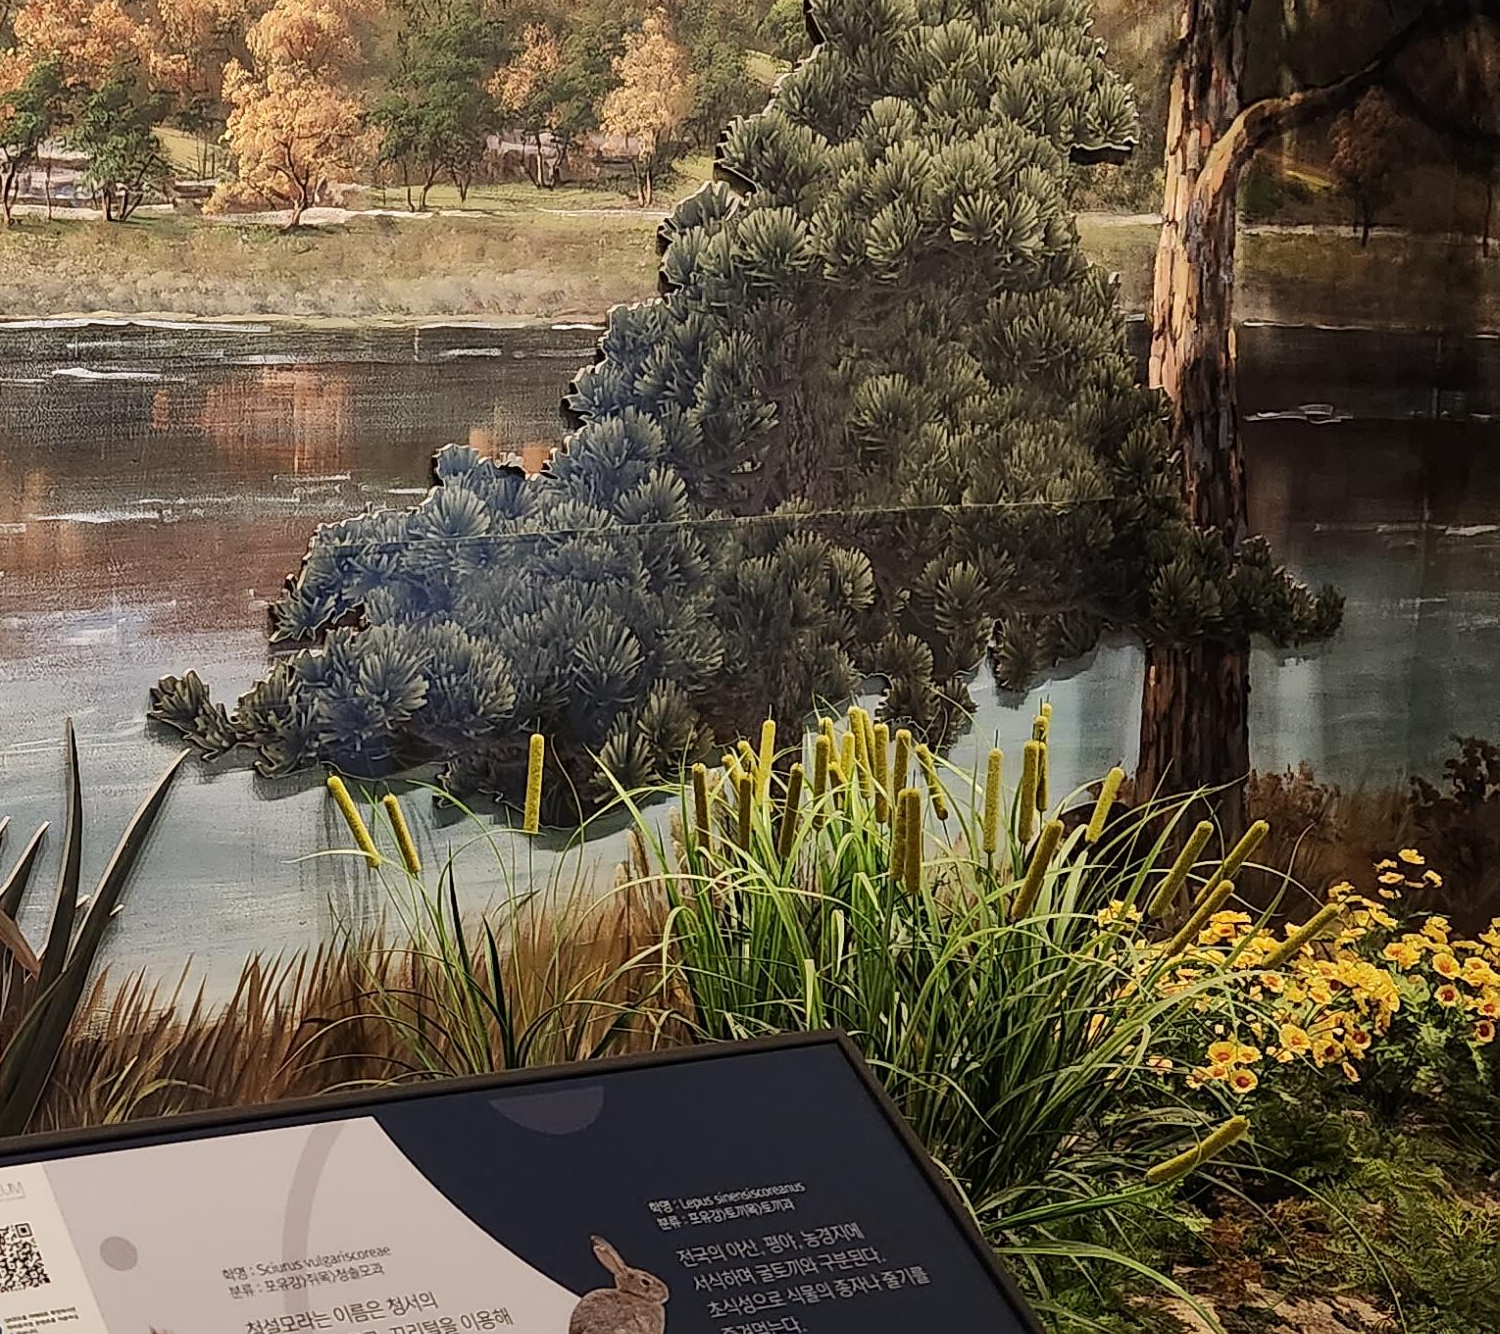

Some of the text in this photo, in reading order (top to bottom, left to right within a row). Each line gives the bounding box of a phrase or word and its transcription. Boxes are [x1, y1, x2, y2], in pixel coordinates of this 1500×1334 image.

[692, 1266, 757, 1292] 서식하며
[753, 1255, 820, 1283] 굴토끼와
[331, 1299, 387, 1324] 이름은
[385, 1290, 439, 1316] 청서의
[459, 1306, 514, 1331] 이용해
